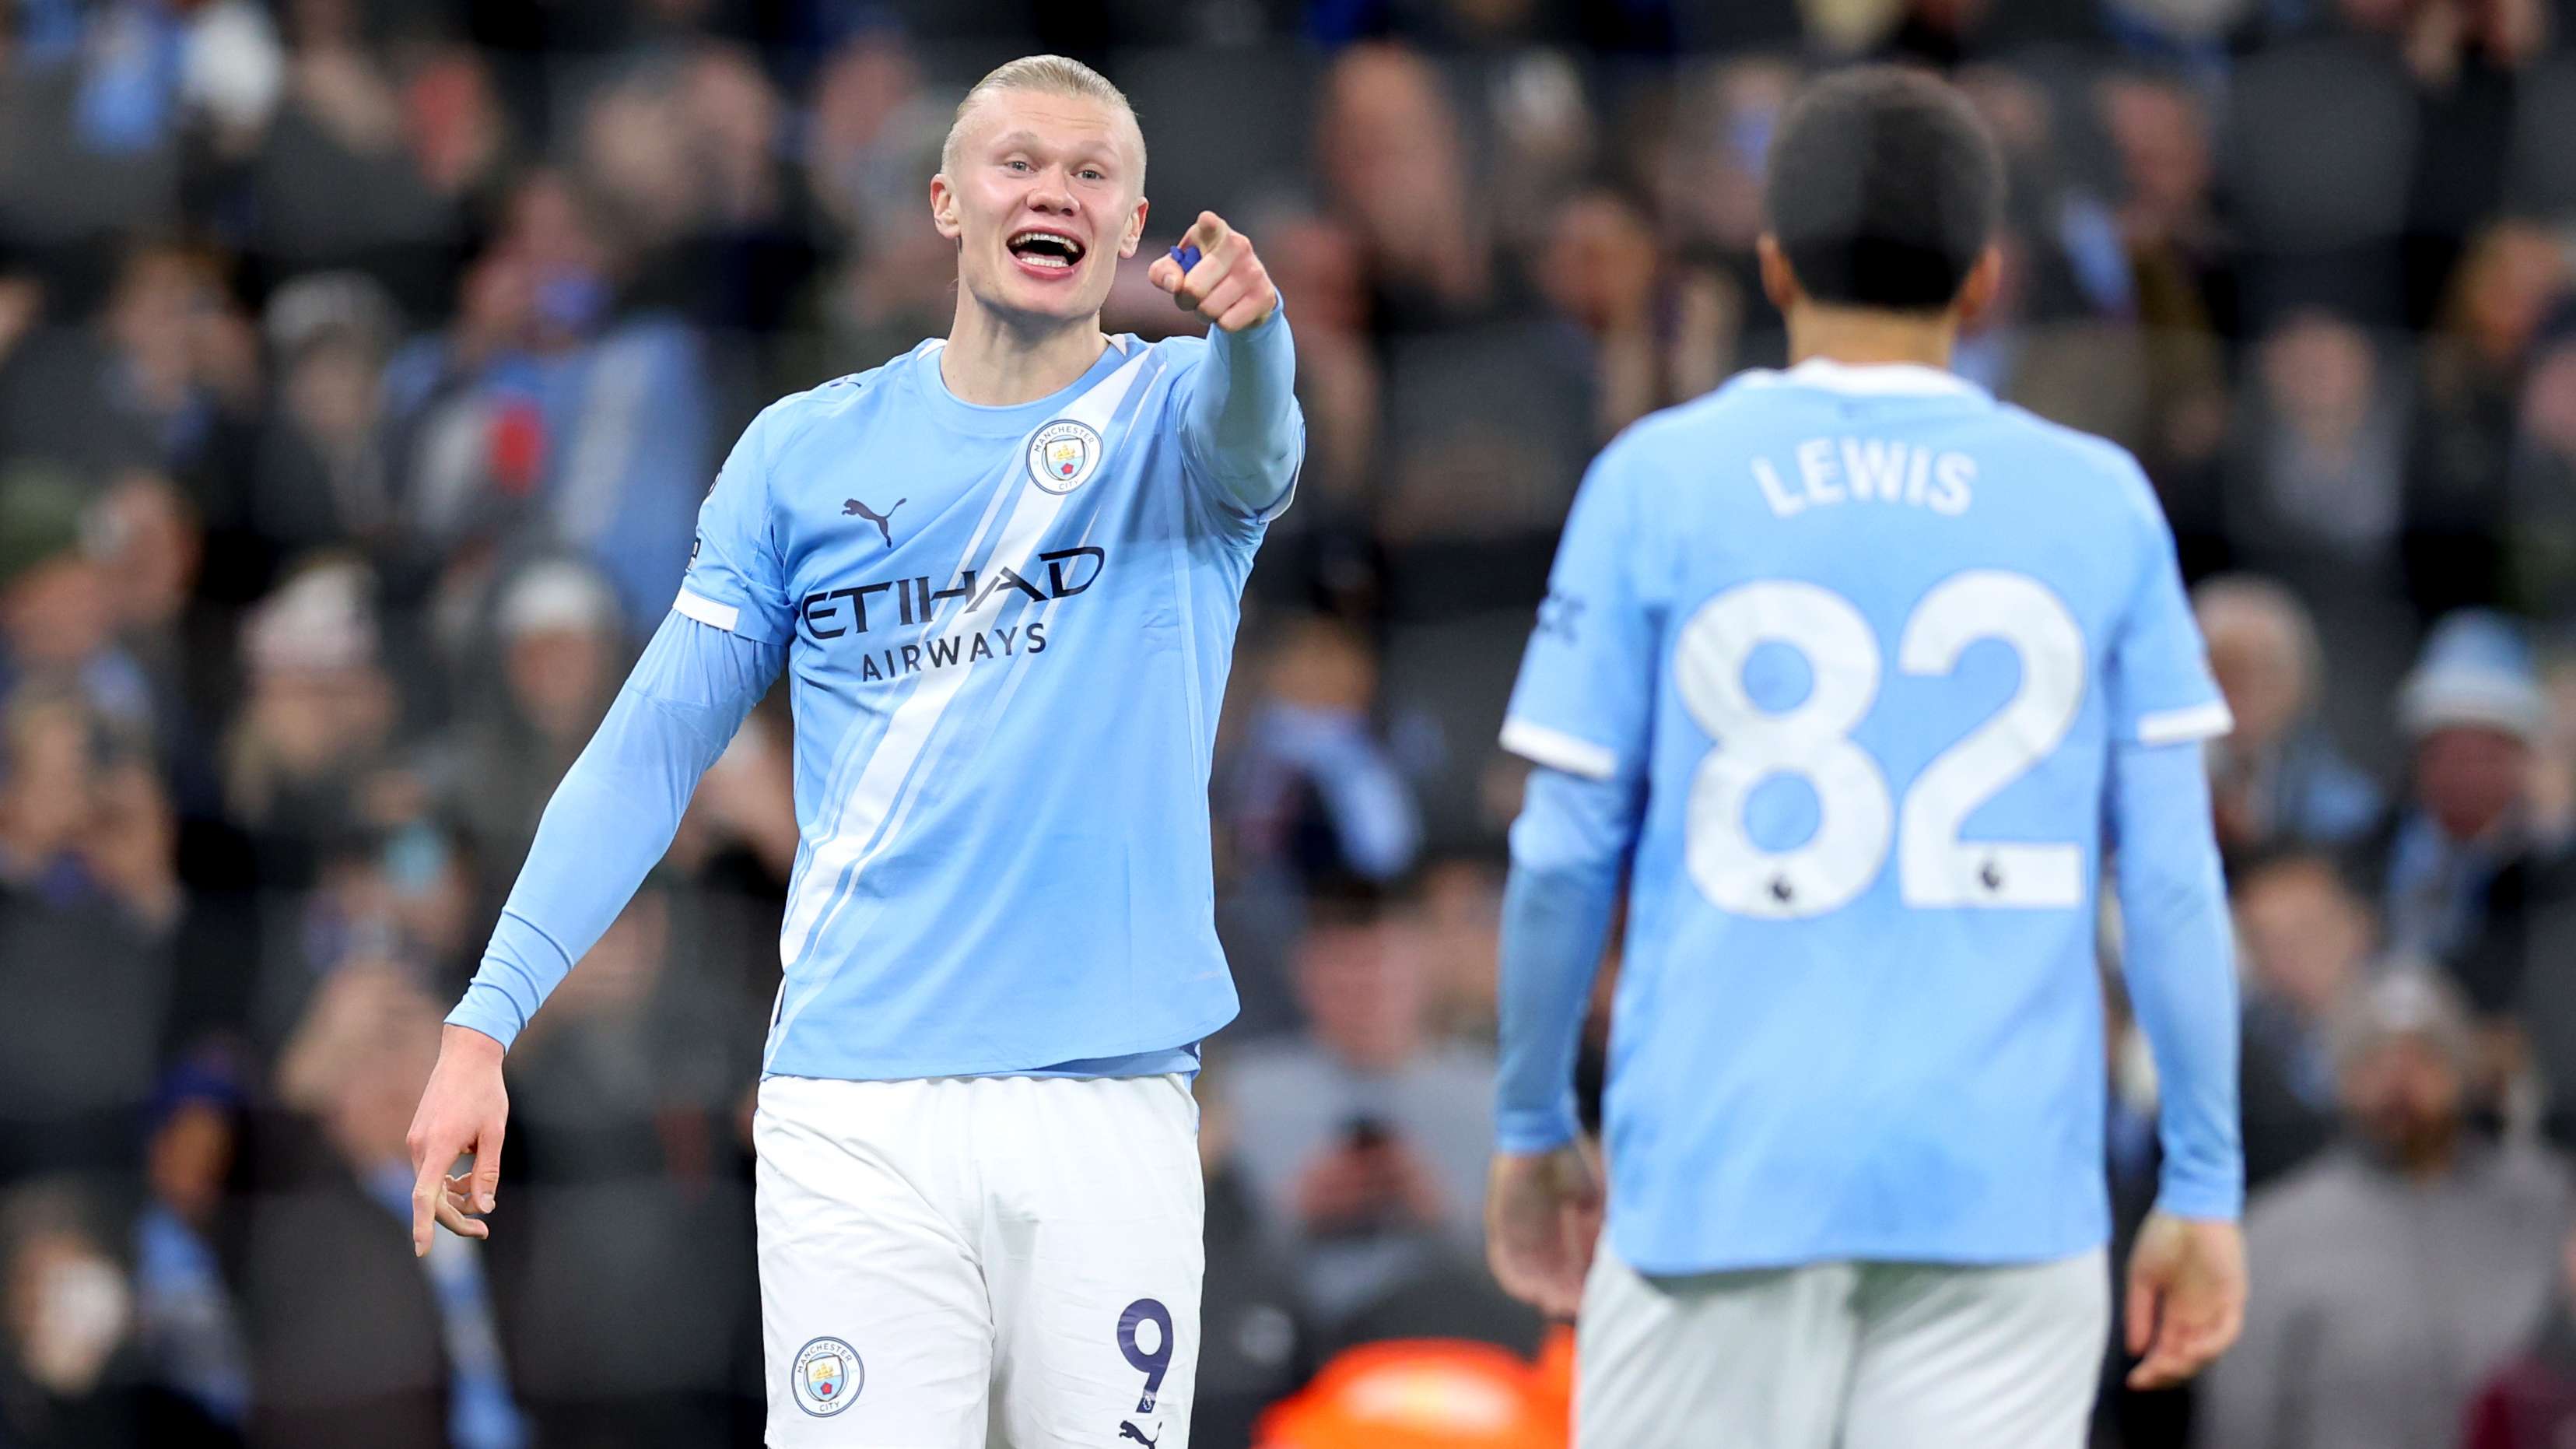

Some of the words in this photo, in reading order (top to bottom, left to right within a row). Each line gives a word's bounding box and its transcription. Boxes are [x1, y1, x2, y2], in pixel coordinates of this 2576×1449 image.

[1034, 426, 1095, 453] MANCHESTER
[1058, 479, 1079, 490] CITY
[1751, 435, 1978, 518] LEWIS
[801, 546, 1105, 640] ETIHAD
[862, 623, 1047, 682] AIRWAYS
[1674, 569, 2087, 920] 82
[797, 1343, 853, 1374] MANCHESTER
[1116, 1298, 1174, 1413] 9
[819, 1401, 840, 1412] CITY
